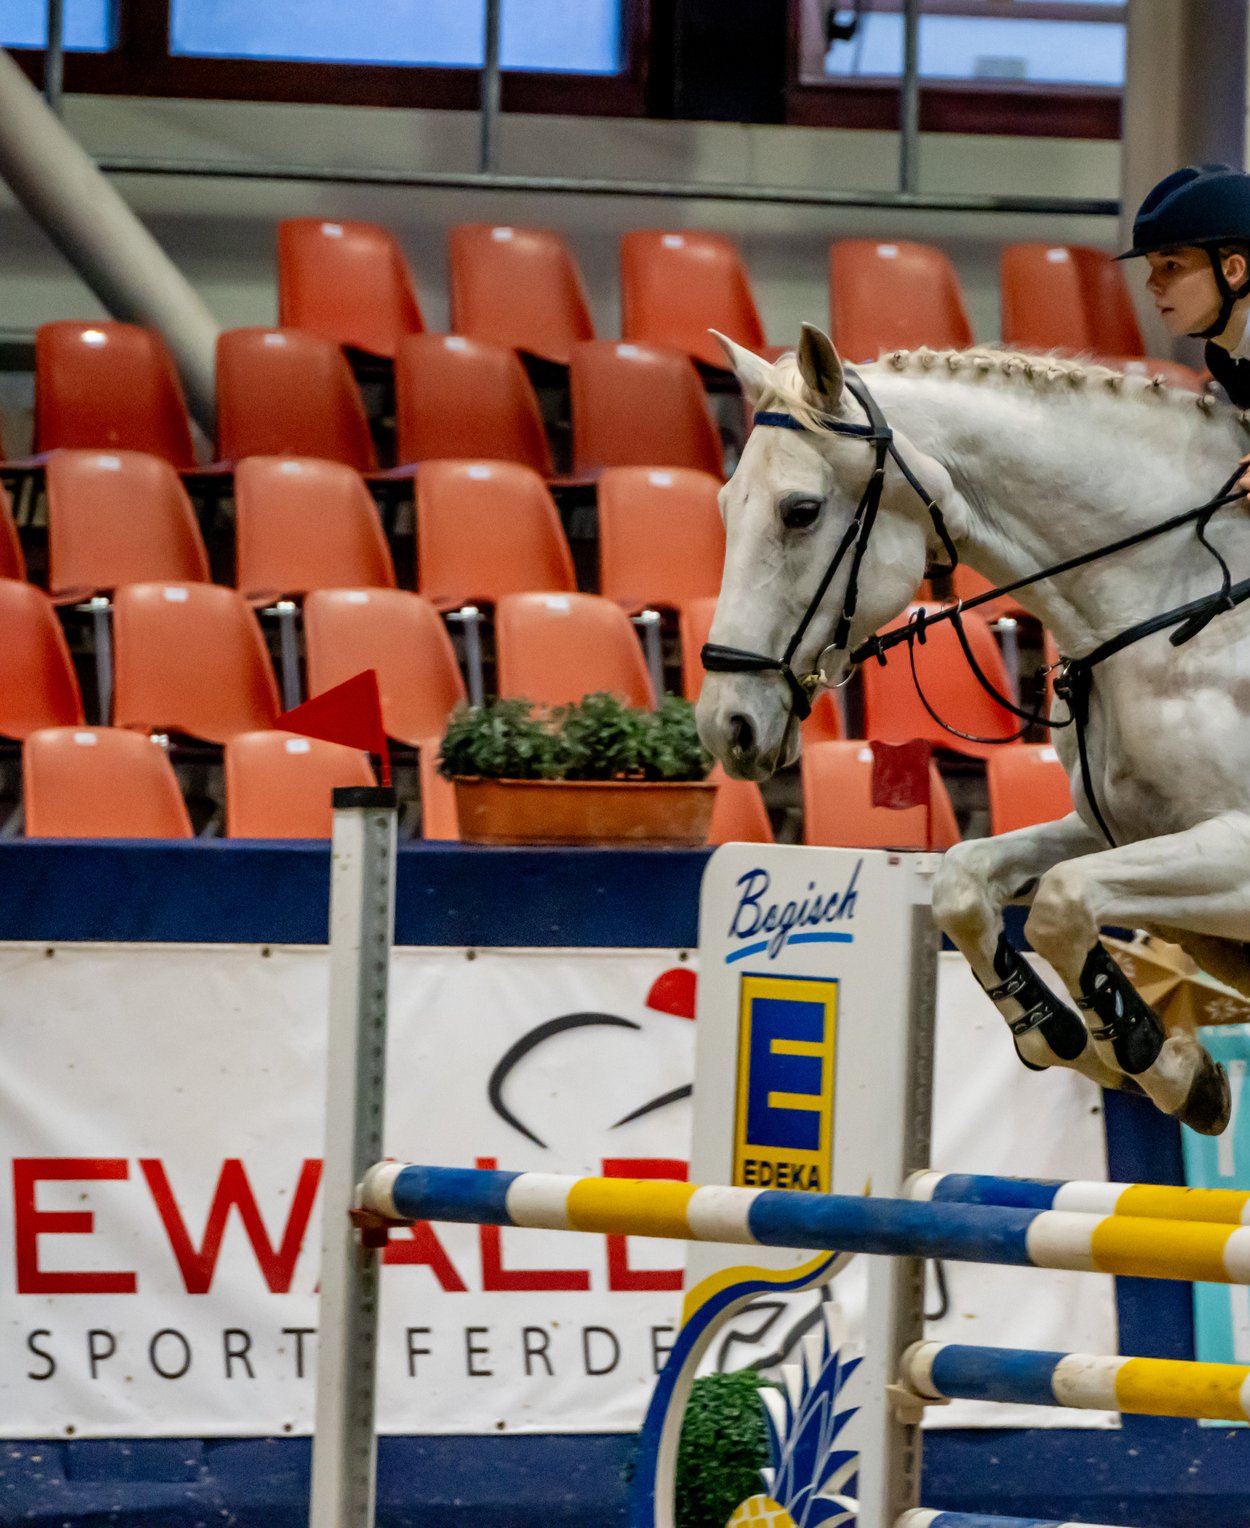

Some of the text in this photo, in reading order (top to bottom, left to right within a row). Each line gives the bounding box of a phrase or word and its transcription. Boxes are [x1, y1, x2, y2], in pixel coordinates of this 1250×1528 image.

[728, 858, 863, 959] Bogisch
[743, 1159, 821, 1190] EDEKA
[26, 1326, 675, 1381] SPORTFERDE
